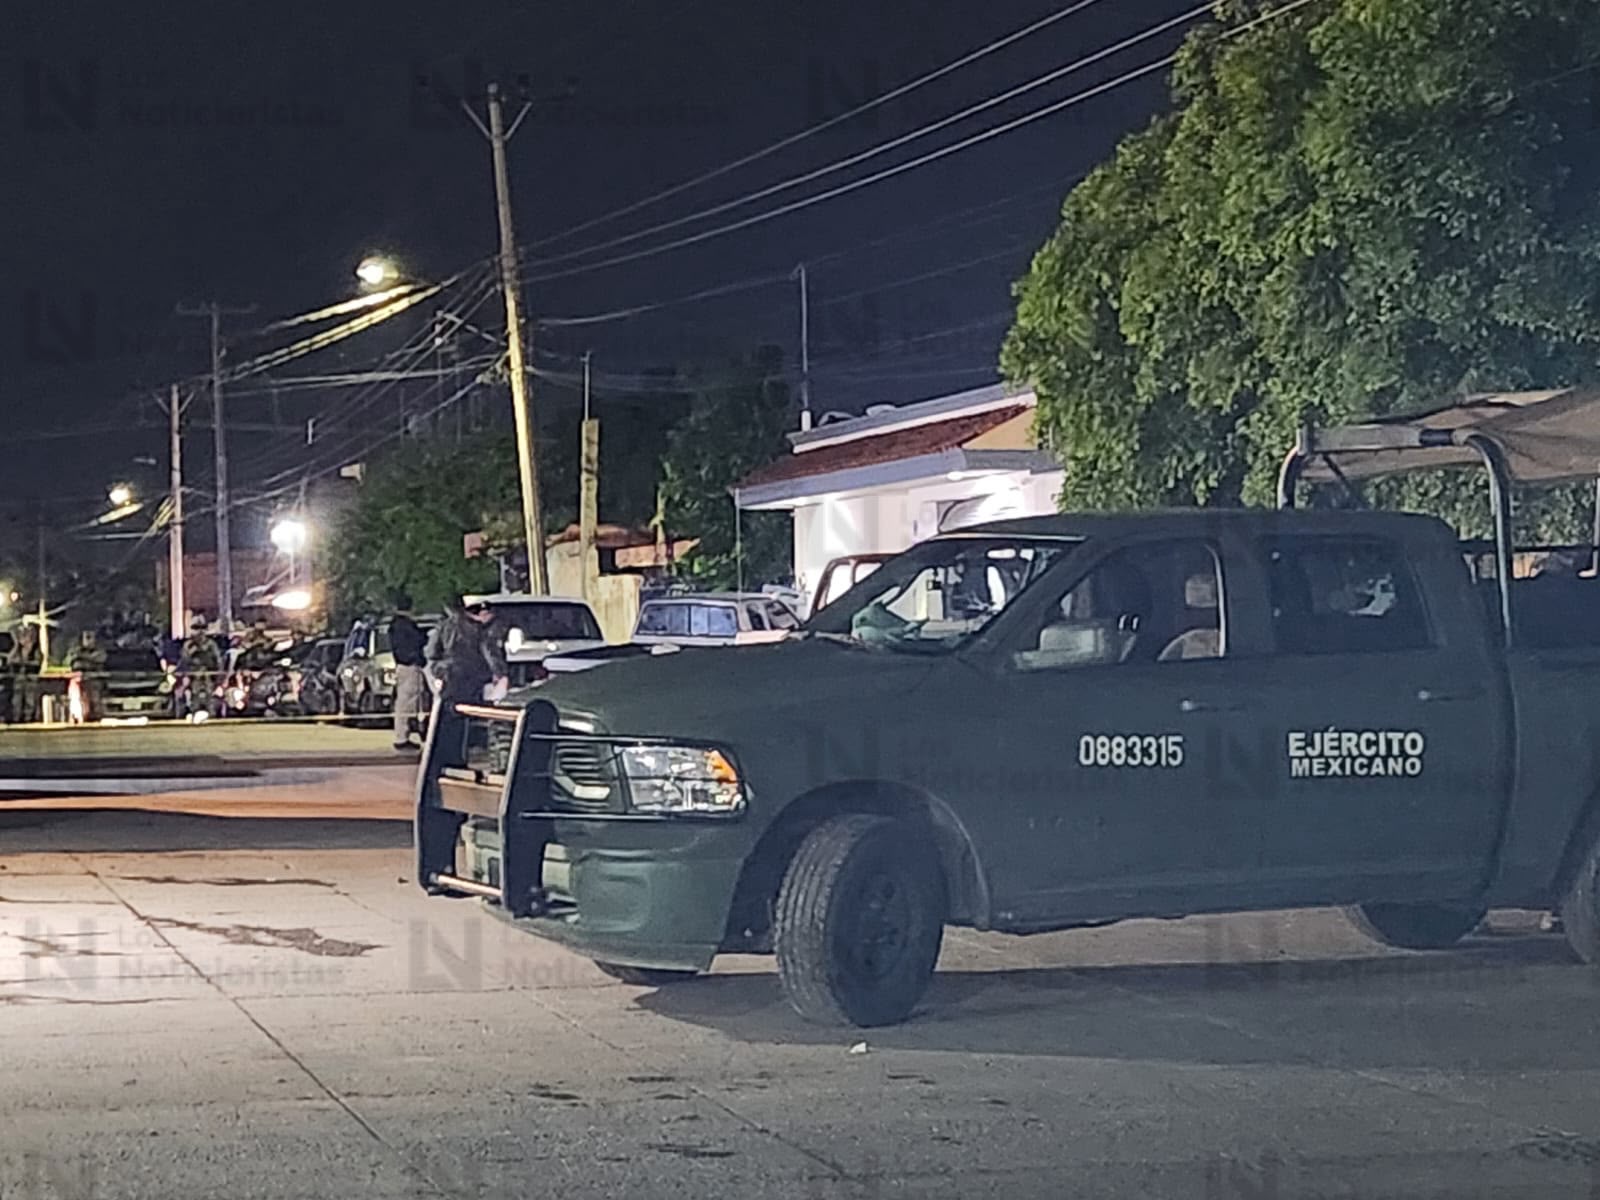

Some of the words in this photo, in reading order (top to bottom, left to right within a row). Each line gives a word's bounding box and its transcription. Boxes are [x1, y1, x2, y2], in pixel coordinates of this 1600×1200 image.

[1078, 734, 1185, 768] 0883315
[1287, 726, 1425, 758] EJÉRCITO
[1290, 757, 1422, 778] MEXICANO
